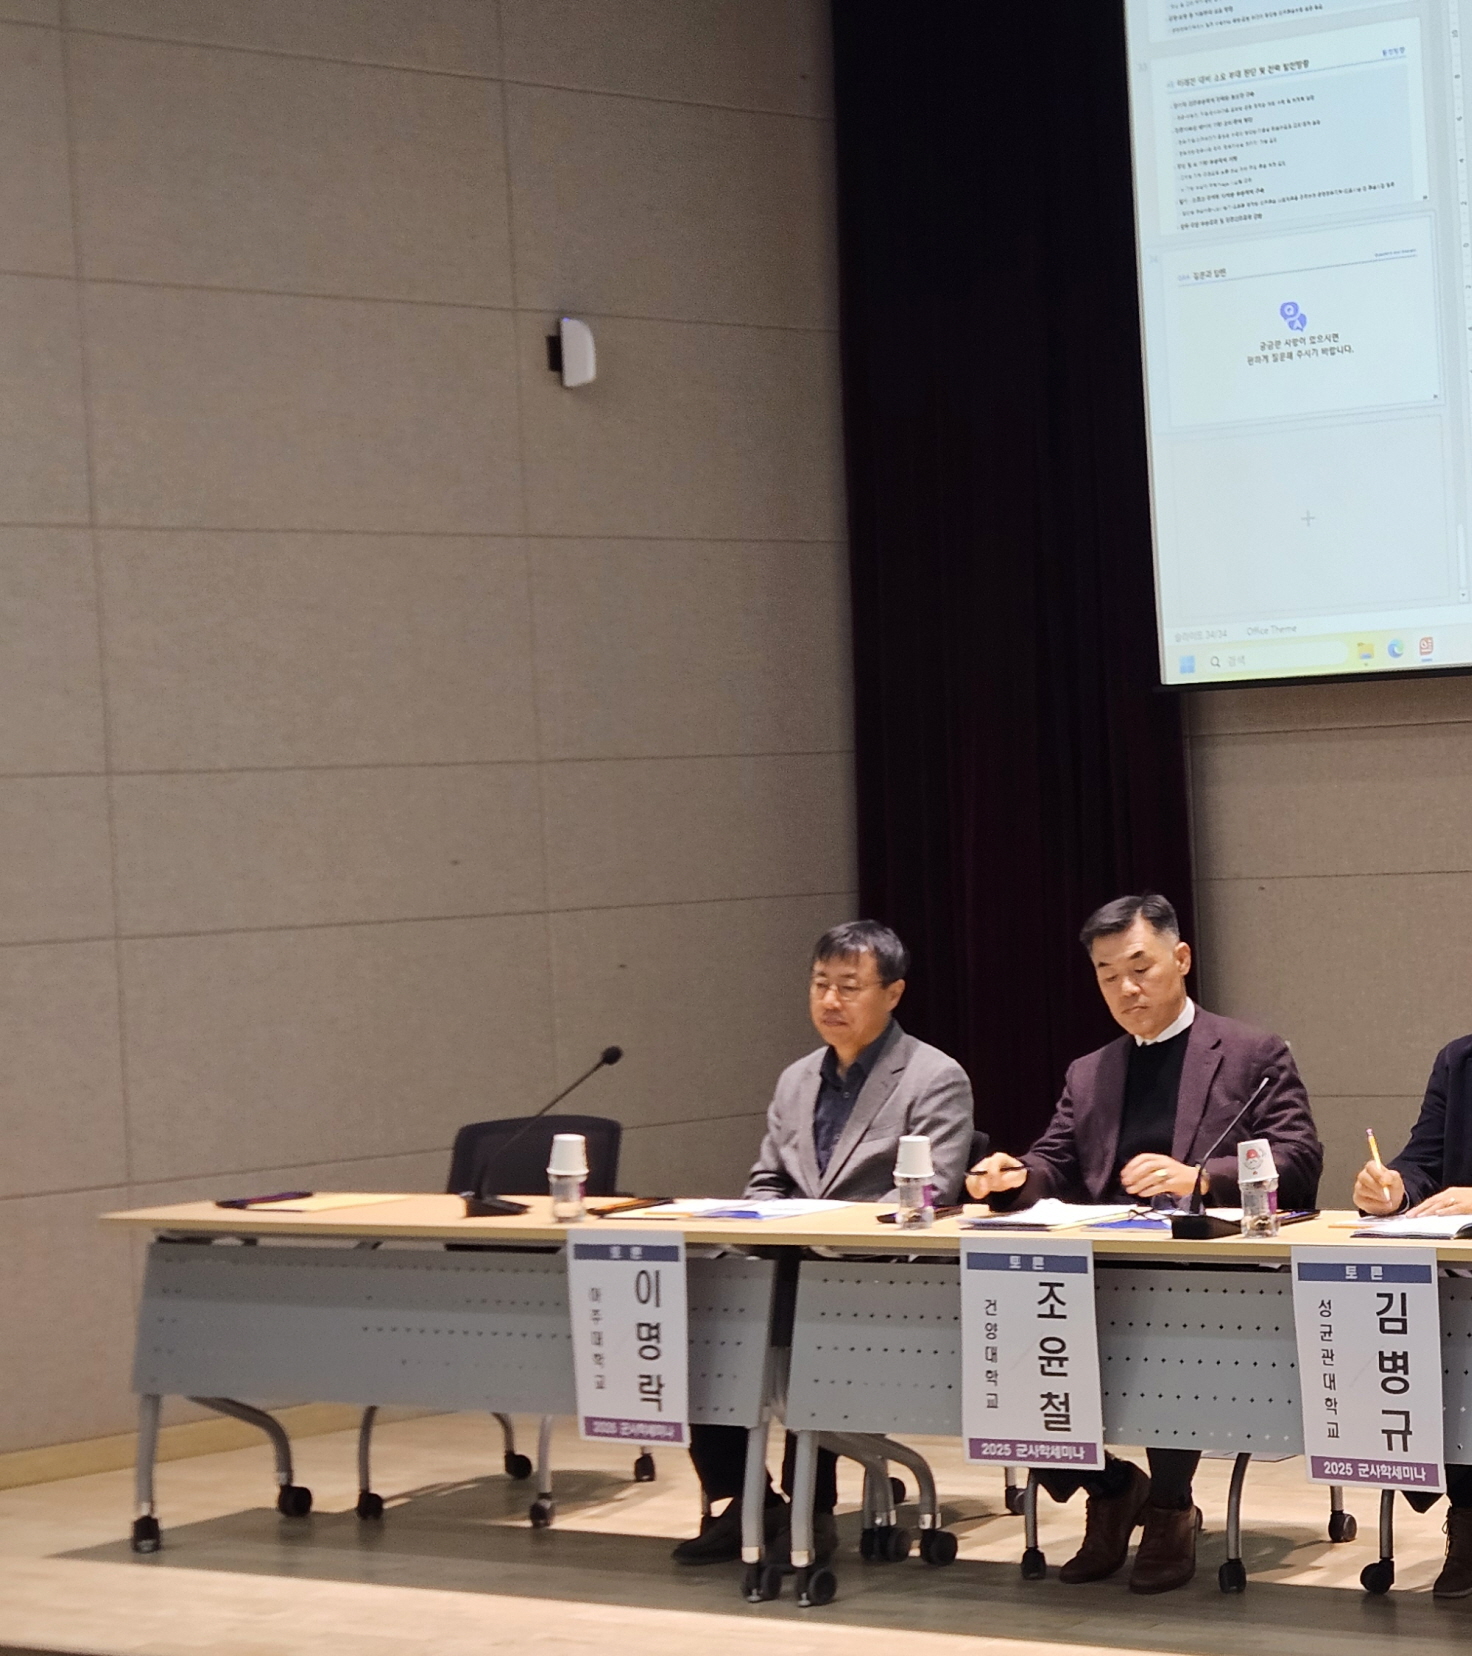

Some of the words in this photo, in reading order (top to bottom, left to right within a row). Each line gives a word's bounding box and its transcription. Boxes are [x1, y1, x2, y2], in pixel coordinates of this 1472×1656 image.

[1247, 625, 1269, 637] Office
[1271, 624, 1297, 634] Theme
[1009, 1255, 1045, 1270] 토론
[1345, 1265, 1383, 1280] 토론
[635, 1270, 665, 1412] 이명락
[984, 1299, 999, 1409] 건양대학교
[1037, 1282, 1071, 1432] 조윤철
[1318, 1299, 1340, 1439] 성균관대학교
[1376, 1292, 1412, 1452] 김병규
[981, 1443, 1011, 1456] 2025
[1015, 1444, 1085, 1460] 군사학세미나
[1323, 1461, 1353, 1476] 2025
[1358, 1463, 1426, 1481] 군사학세미나
